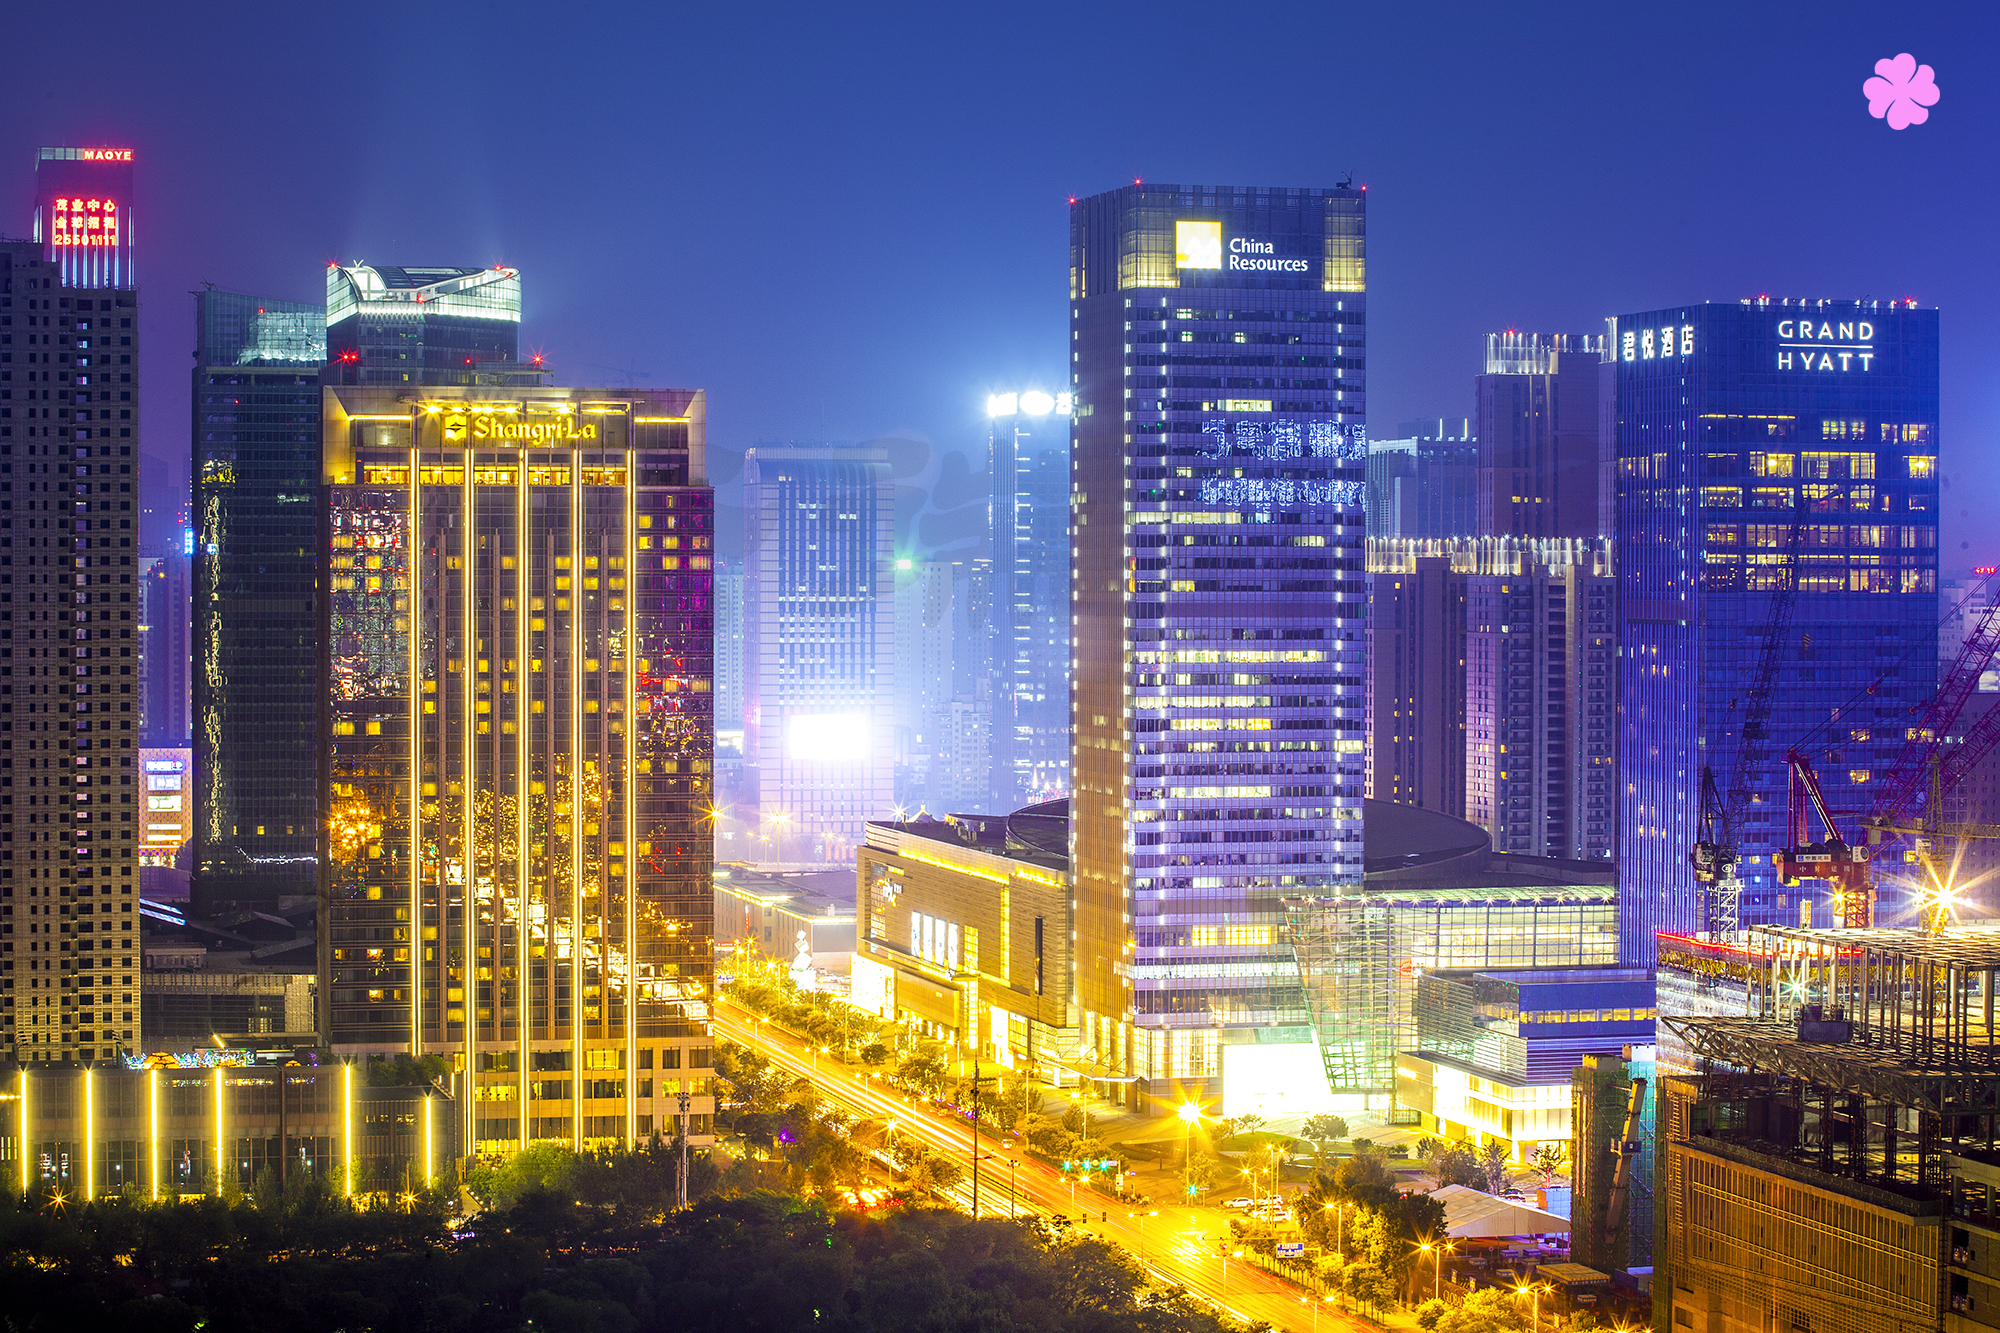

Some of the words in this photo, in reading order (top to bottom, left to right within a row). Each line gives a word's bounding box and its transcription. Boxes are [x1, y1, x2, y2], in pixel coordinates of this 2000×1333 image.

[84, 150, 132, 160] MAOYE
[55, 198, 116, 212] 茂业中心
[1229, 238, 1274, 254] China
[1229, 255, 1309, 272] Resources
[1778, 320, 1874, 341] GRAND
[1623, 324, 1694, 361] 君悦酒店
[1778, 352, 1874, 371] HYATT
